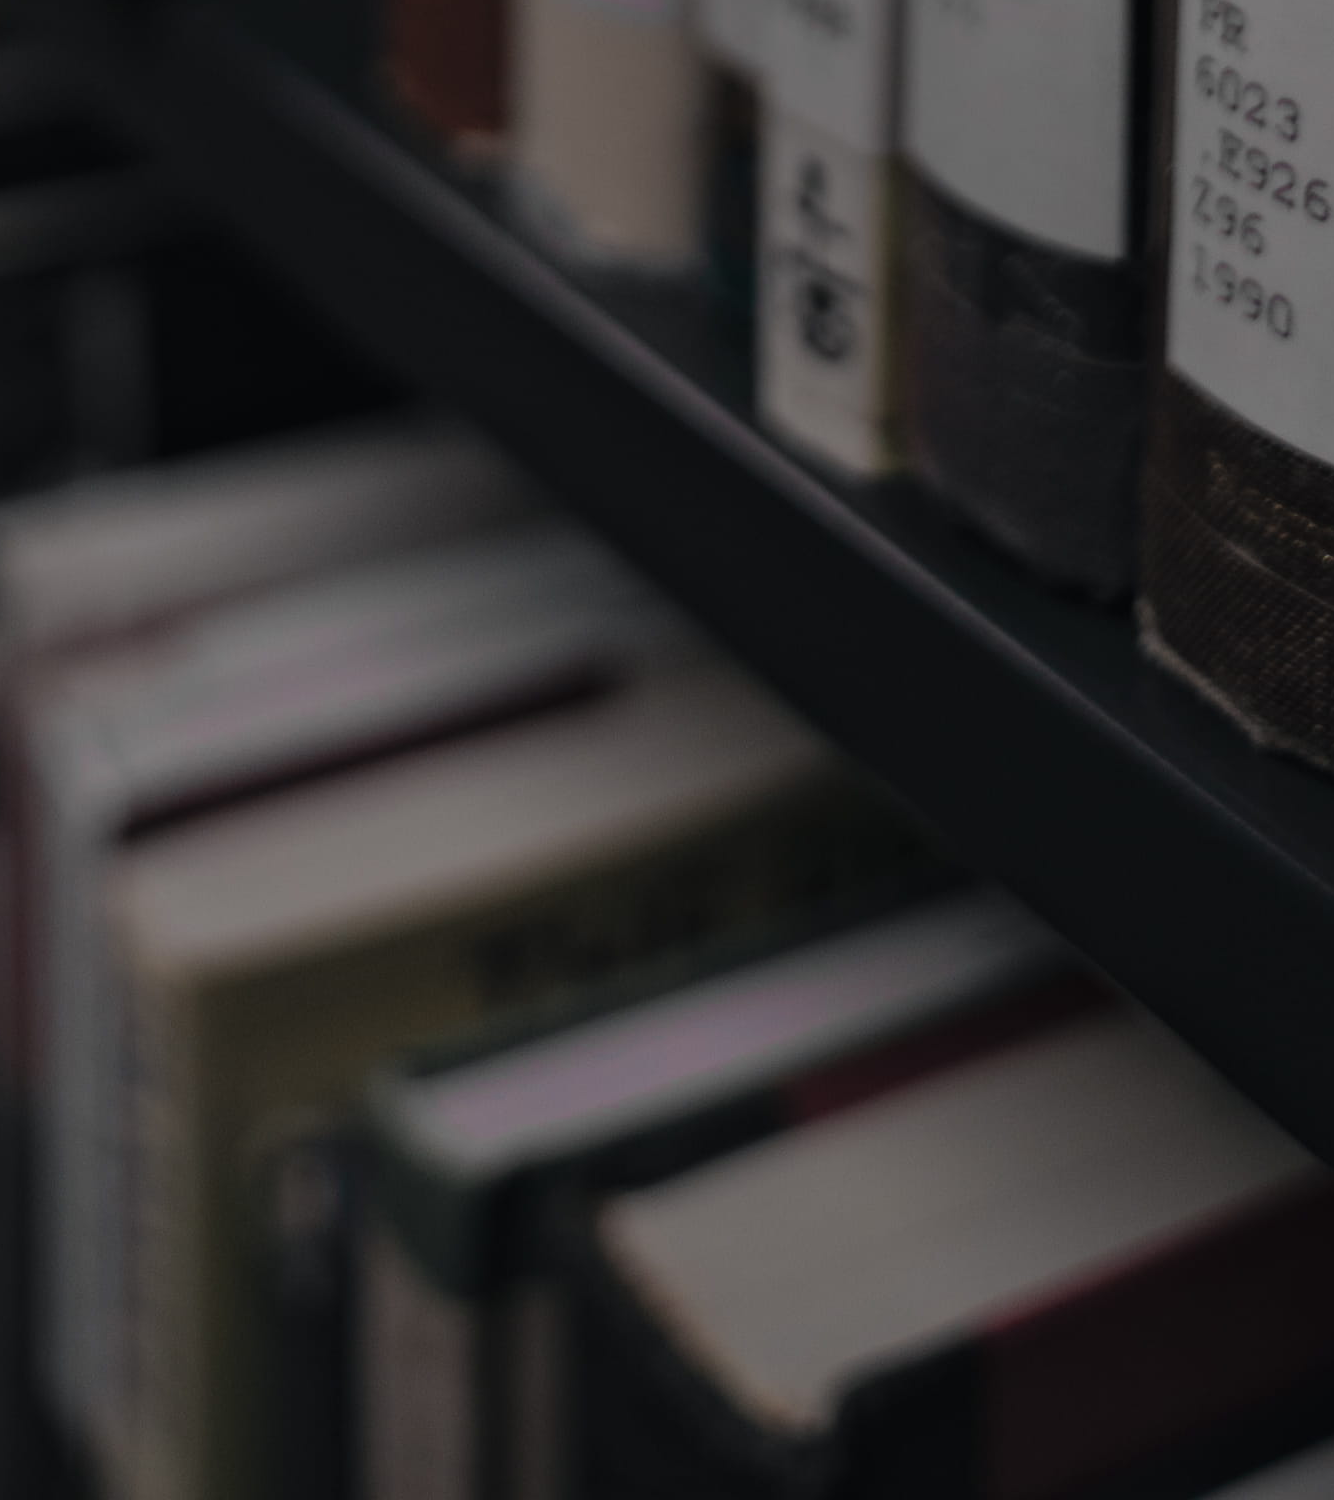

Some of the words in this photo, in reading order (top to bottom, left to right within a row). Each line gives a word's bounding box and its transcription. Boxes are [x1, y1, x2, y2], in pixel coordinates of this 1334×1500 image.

[1193, 55, 1303, 142] 6023
[1190, 178, 1268, 257] Z96
[1199, 127, 1333, 227] .E926
[1188, 242, 1296, 341] 1990
